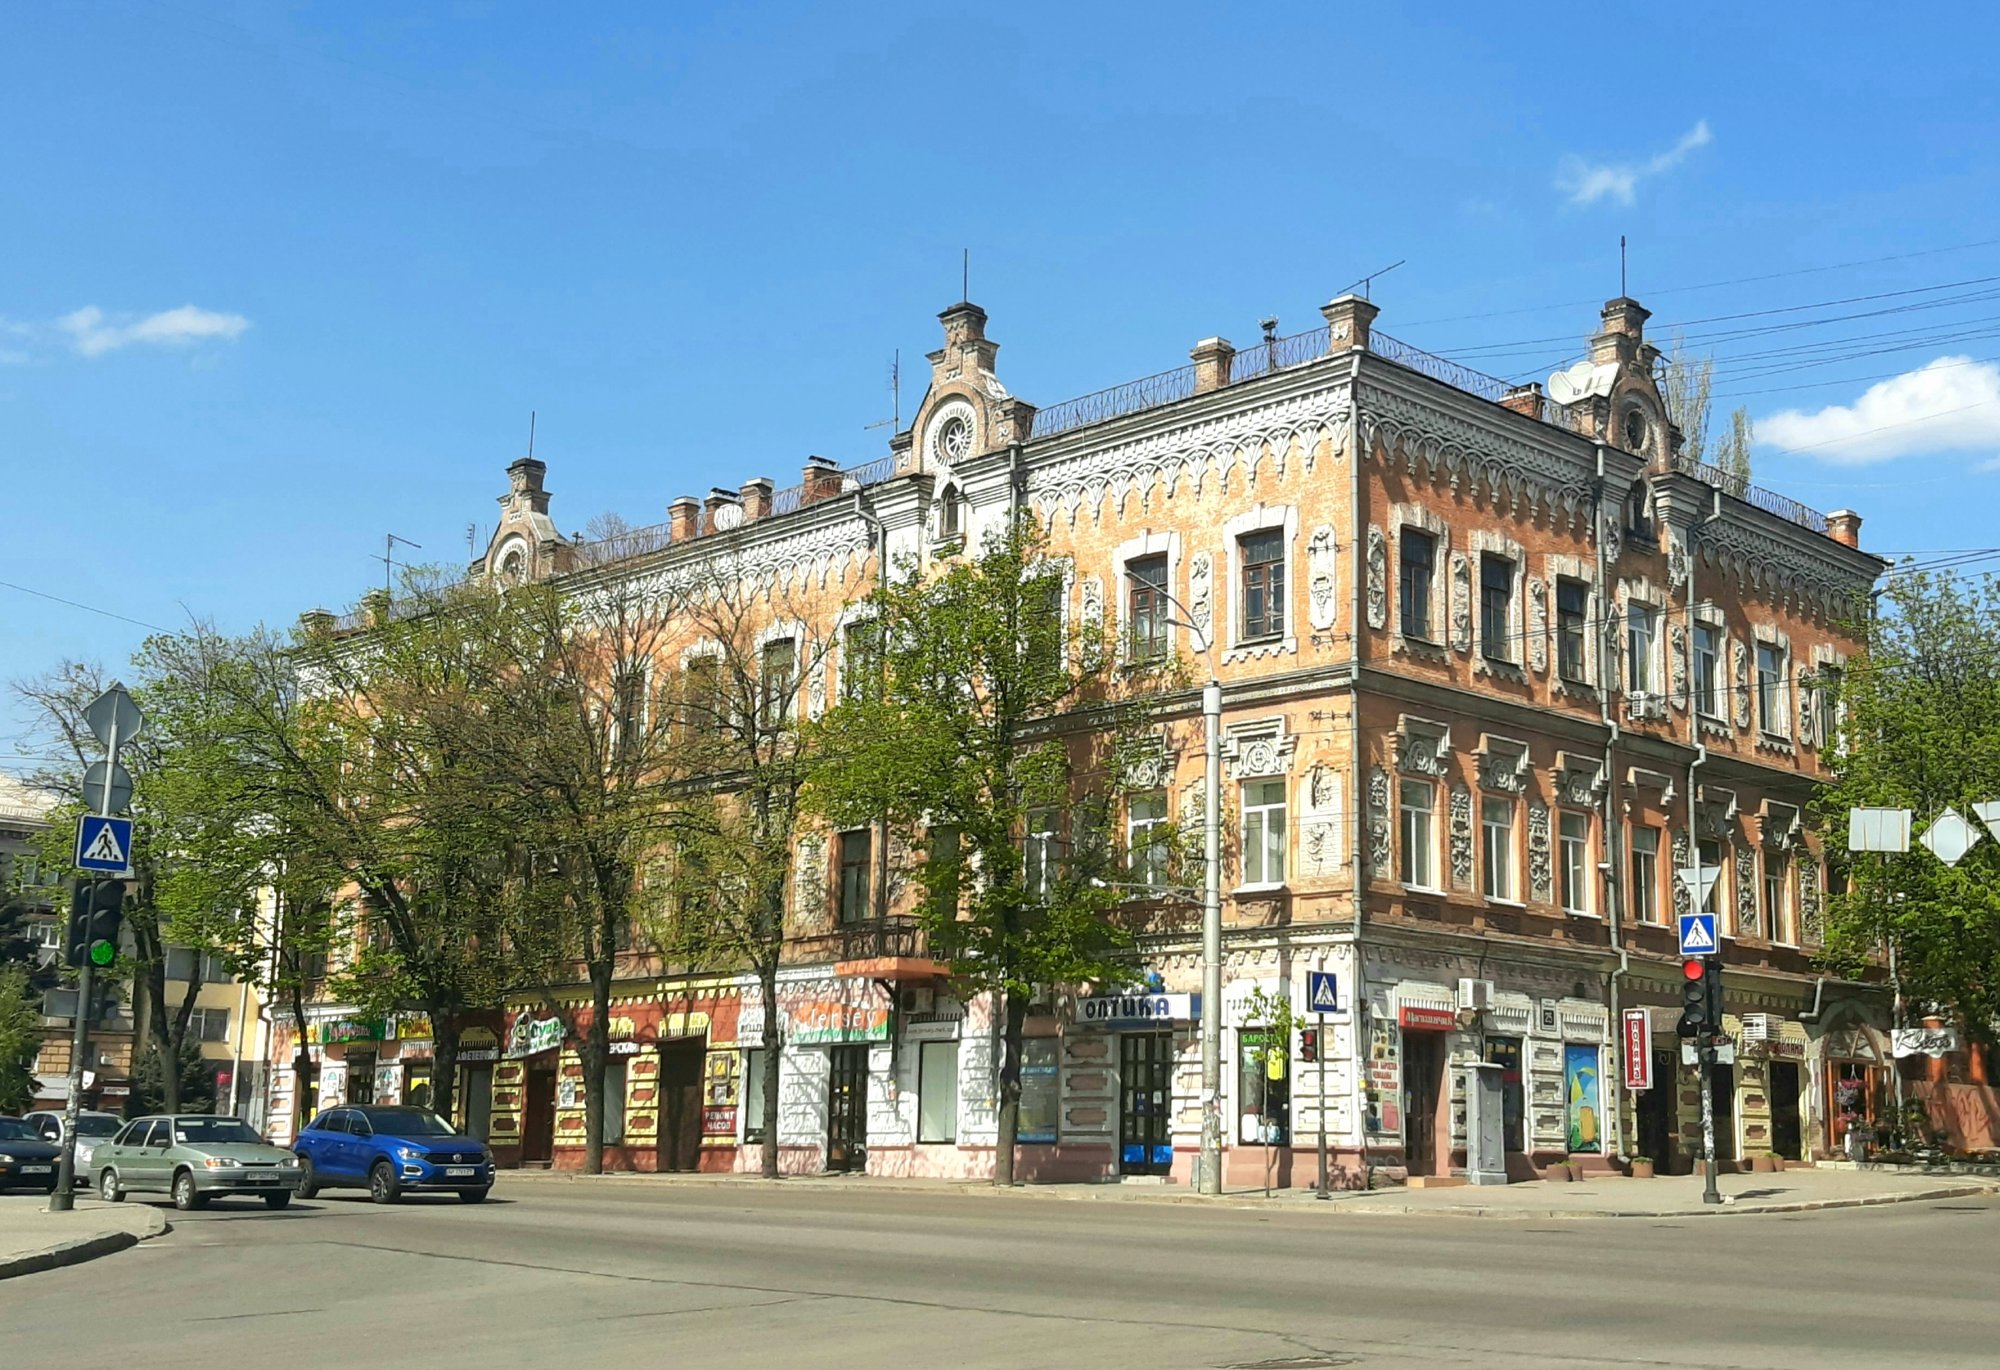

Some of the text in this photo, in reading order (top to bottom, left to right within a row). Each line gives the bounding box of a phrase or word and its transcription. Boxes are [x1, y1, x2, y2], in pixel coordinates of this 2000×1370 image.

[1085, 997, 1169, 1019] ОПТИКА
[808, 1007, 877, 1033] Jersey
[705, 1111, 735, 1120] РЕМОНТ
